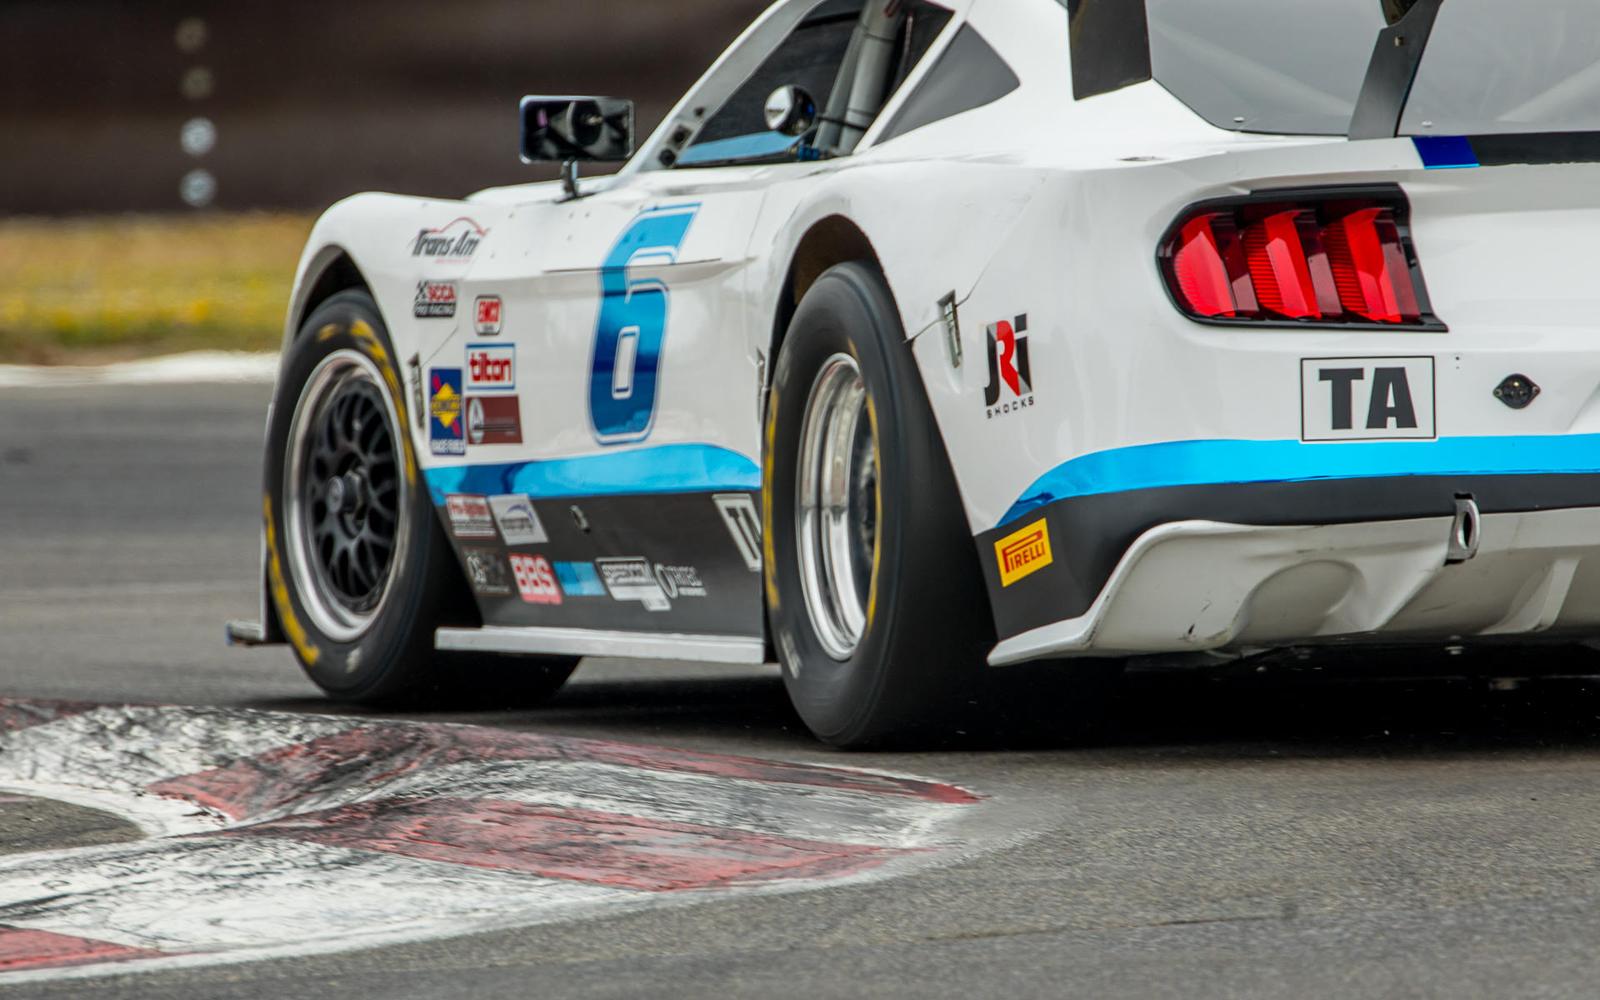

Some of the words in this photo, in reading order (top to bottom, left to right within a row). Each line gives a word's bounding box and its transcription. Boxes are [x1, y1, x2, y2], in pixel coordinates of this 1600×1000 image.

[411, 229, 455, 256] Trans
[449, 229, 480, 256] Am
[587, 202, 702, 446] 6
[469, 352, 512, 383] tilton
[986, 396, 1034, 419] SHOCKS
[1319, 366, 1418, 430] TA
[1002, 530, 1045, 574] PIRELLI
[510, 556, 560, 596] BBS
